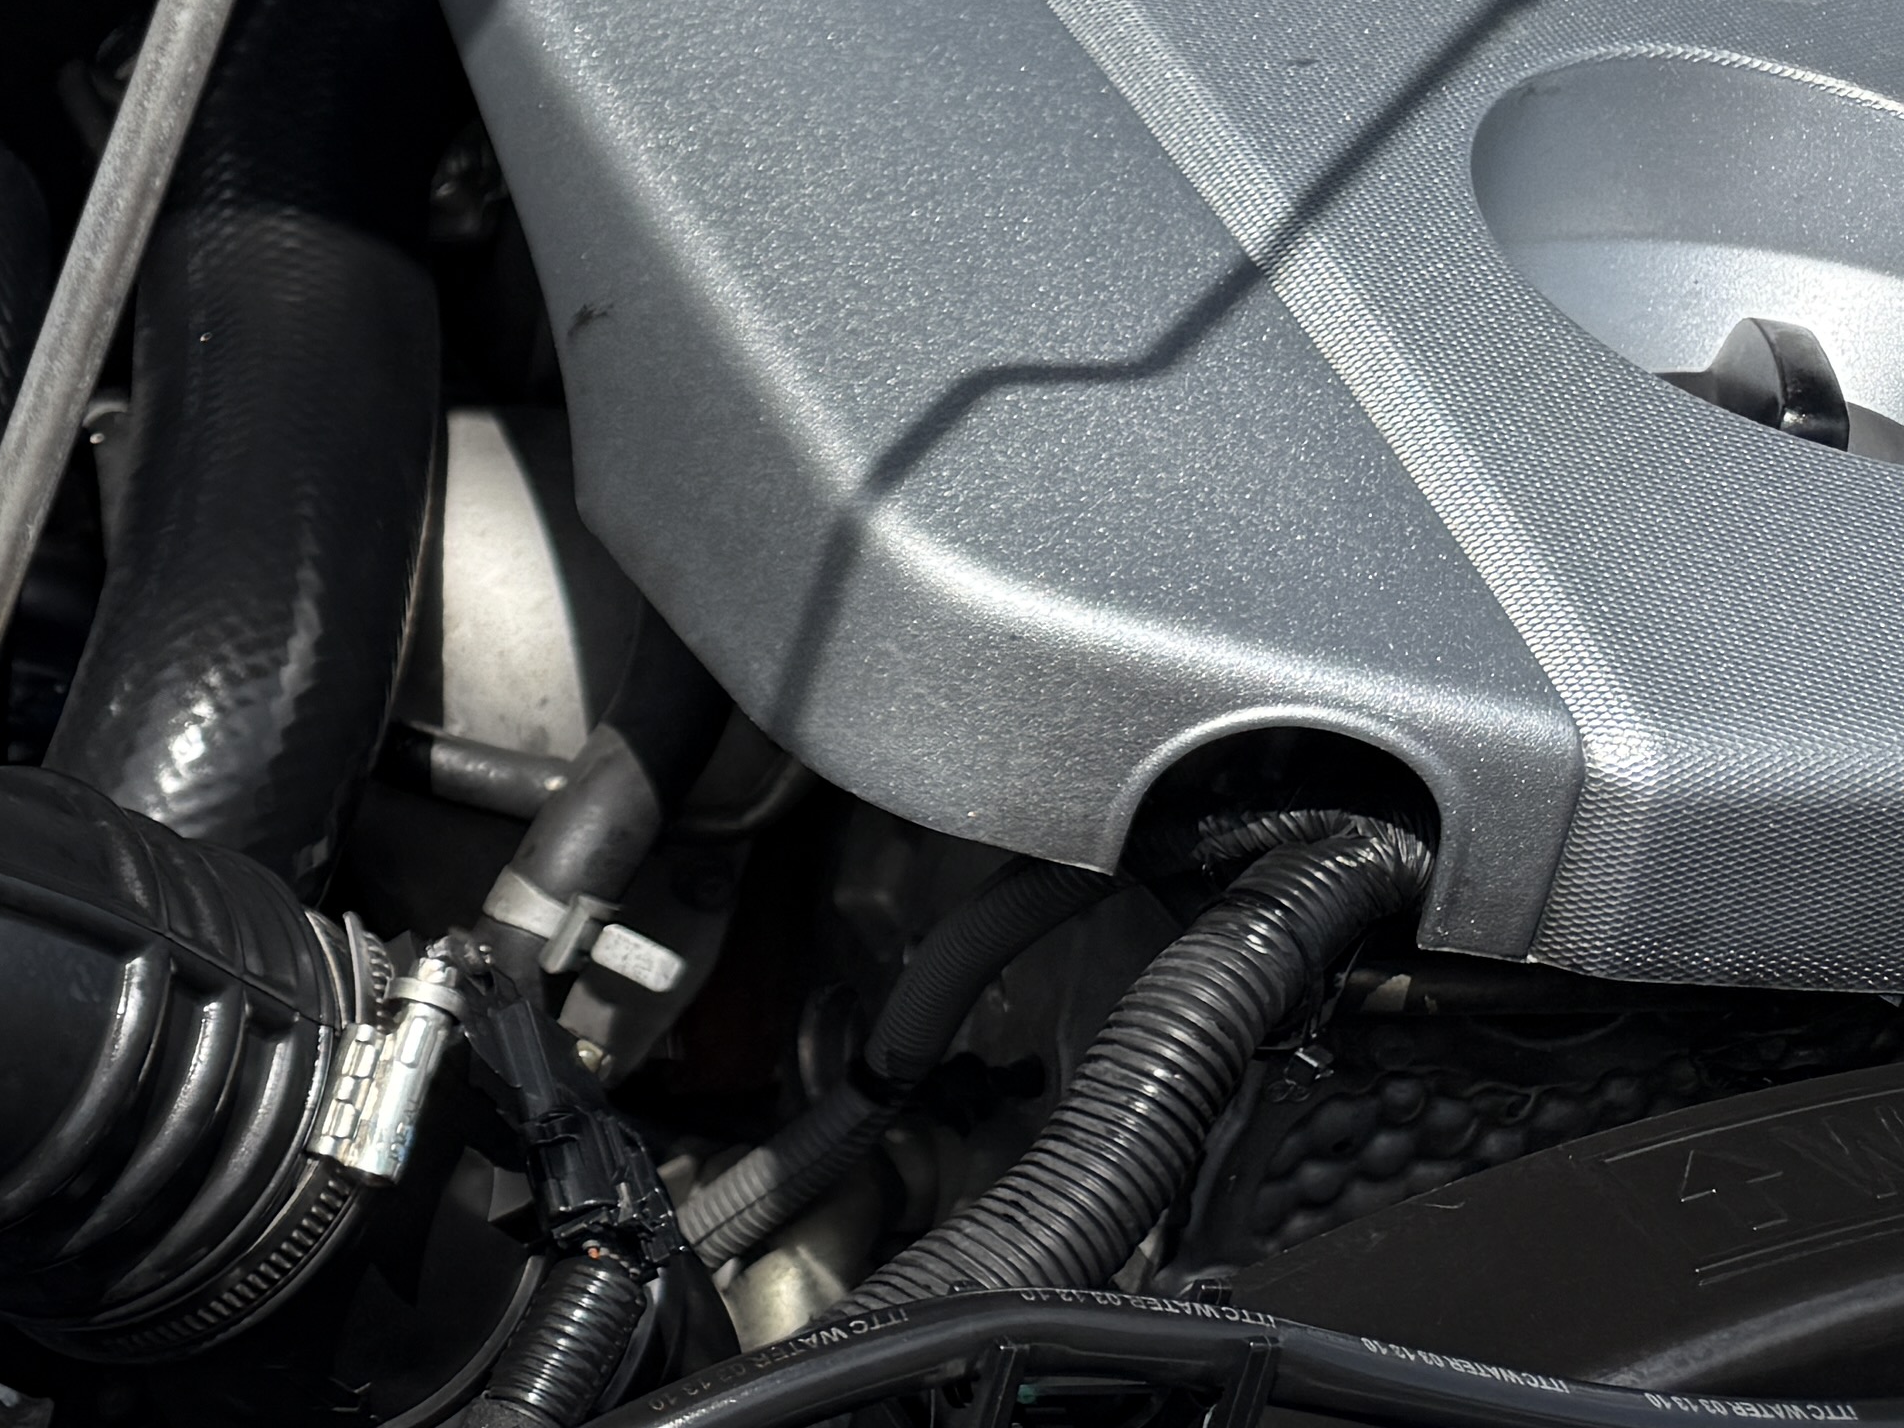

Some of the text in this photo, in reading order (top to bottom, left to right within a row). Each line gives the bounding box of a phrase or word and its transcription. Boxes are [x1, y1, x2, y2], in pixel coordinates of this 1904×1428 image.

[748, 1325, 849, 1369] WATER
[1360, 1336, 1388, 1356] 10
[1444, 1355, 1526, 1385] WATER
[1643, 1392, 1672, 1410] 10
[1726, 1400, 1810, 1420] WATER
